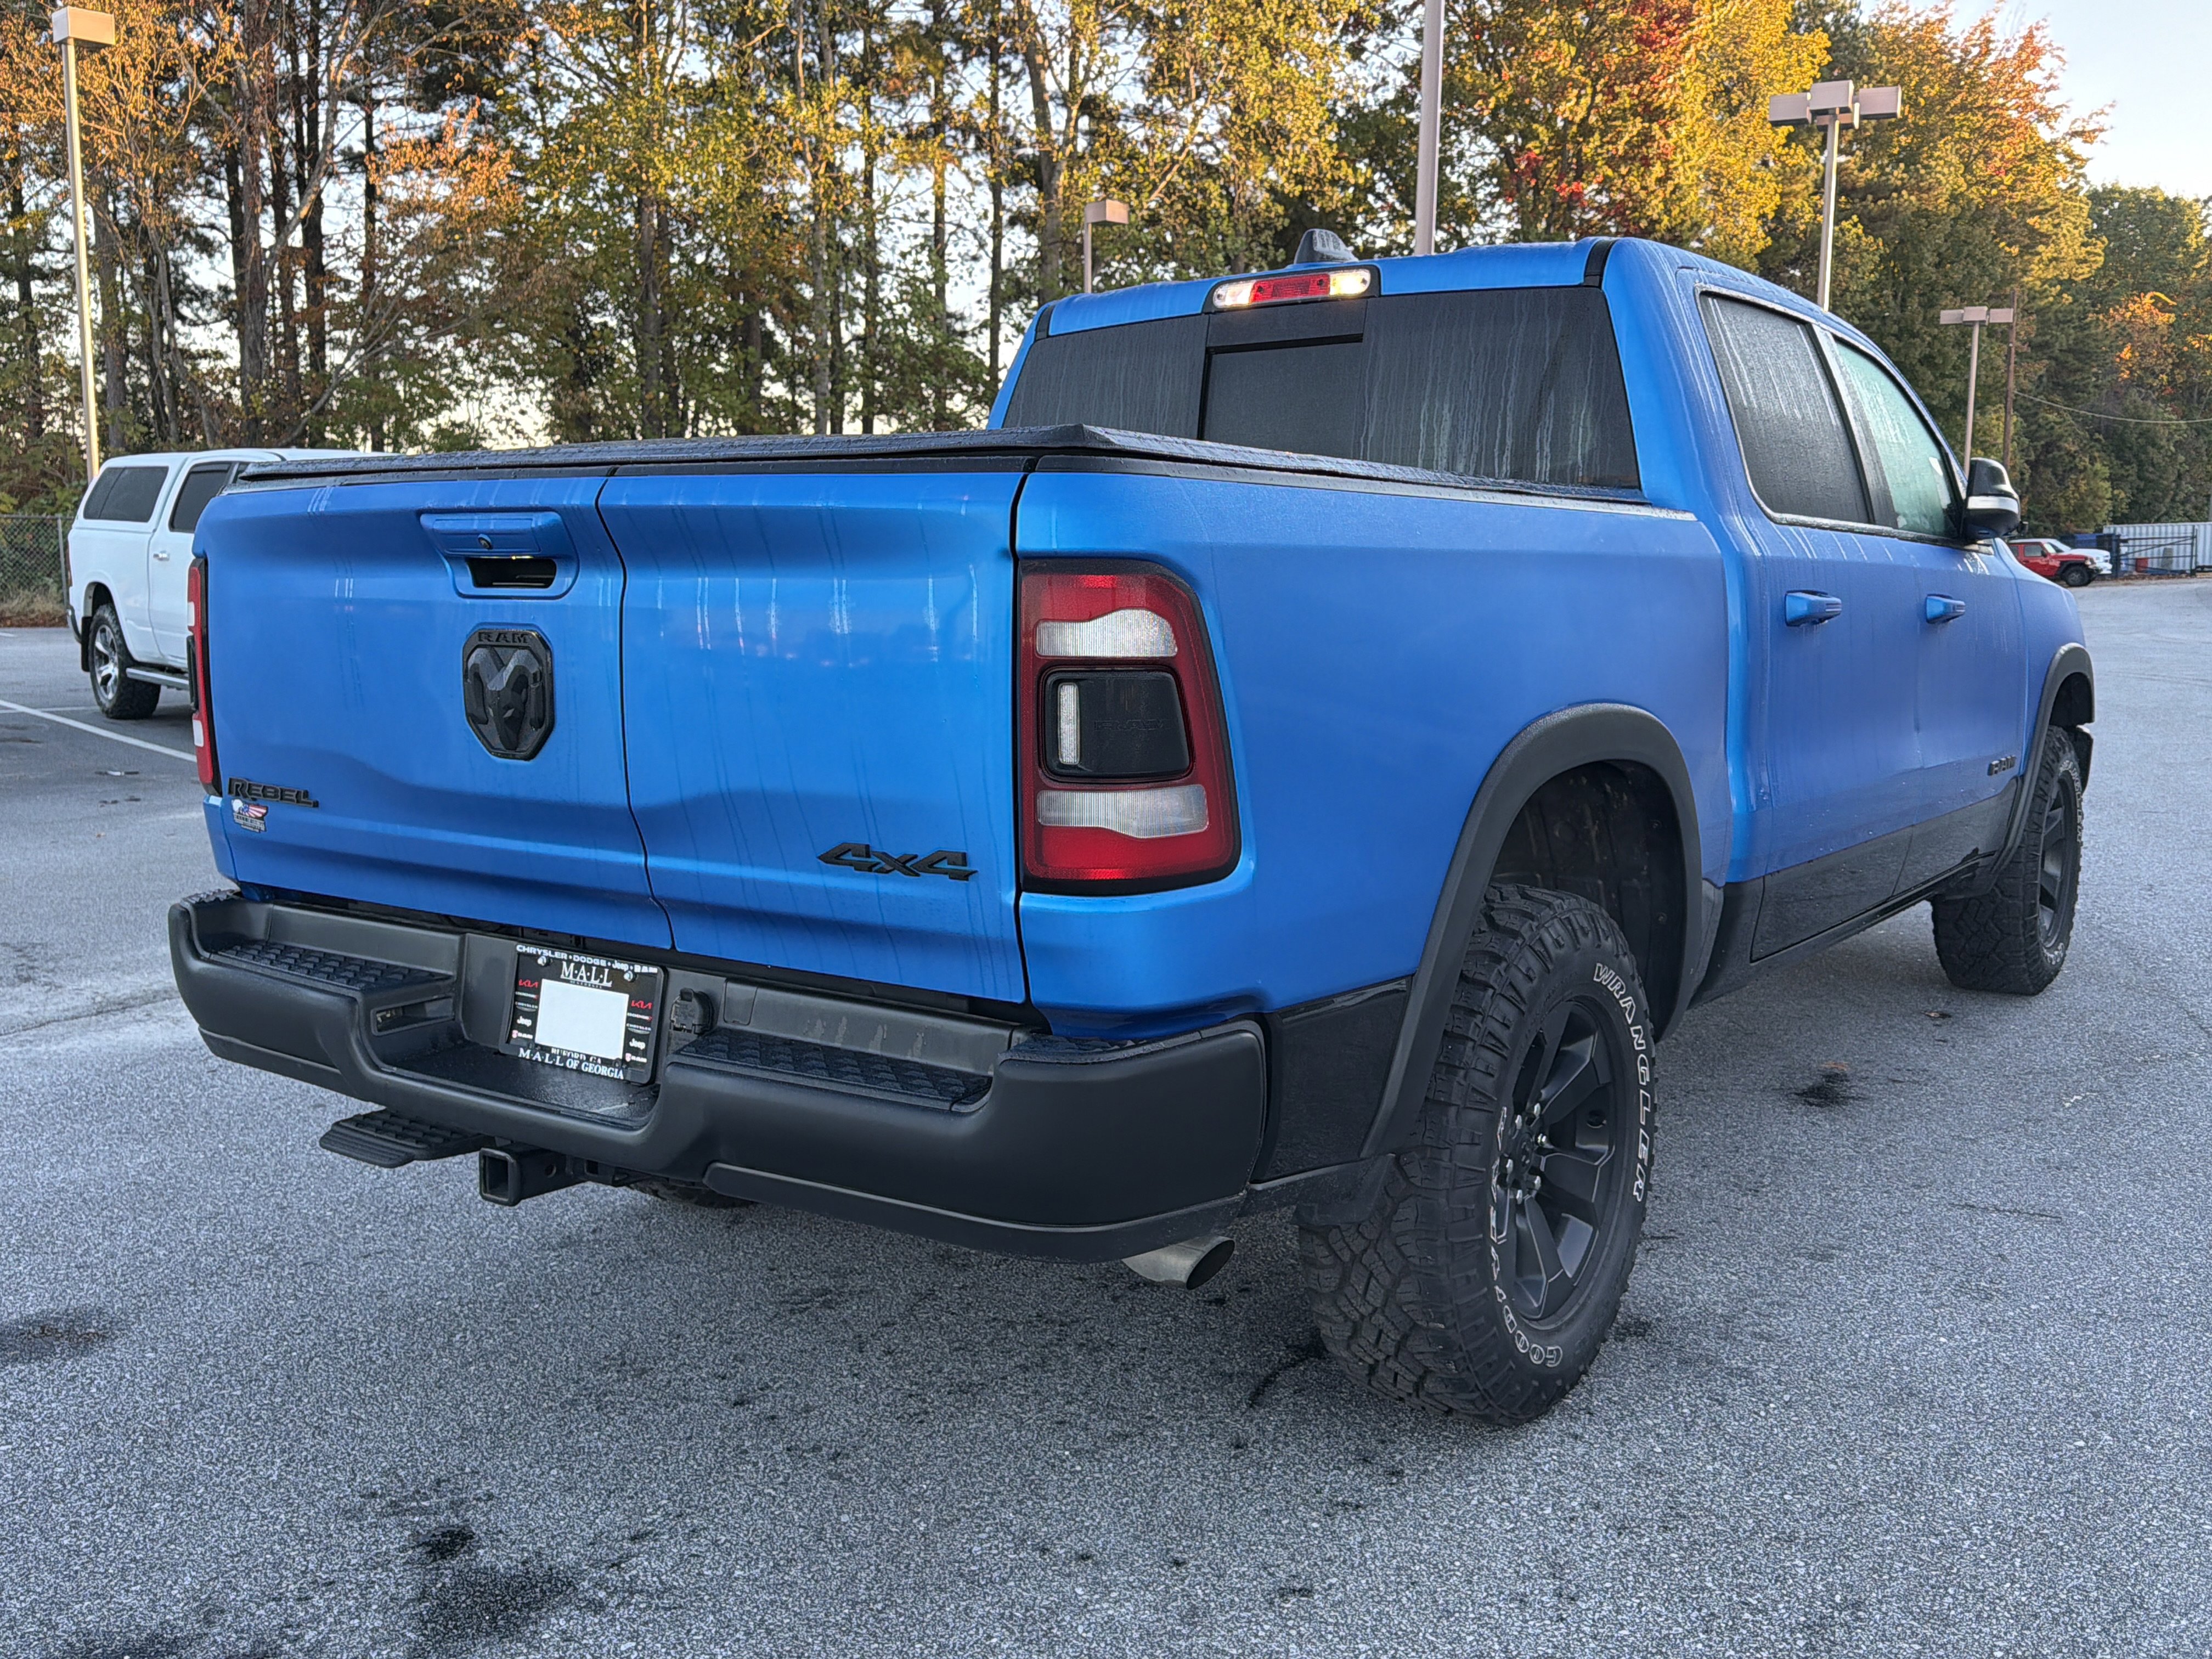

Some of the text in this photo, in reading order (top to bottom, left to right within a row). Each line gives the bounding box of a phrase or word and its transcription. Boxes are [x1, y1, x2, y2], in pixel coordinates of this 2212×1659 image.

[478, 631, 529, 644] RAM
[228, 777, 319, 808] REBEL
[516, 944, 658, 974] CHRYSLER DODGE Jeep RAM
[566, 1058, 580, 1069] OF
[581, 1062, 624, 1080] GEORGIA
[1593, 962, 1651, 1203] WRANGLER
